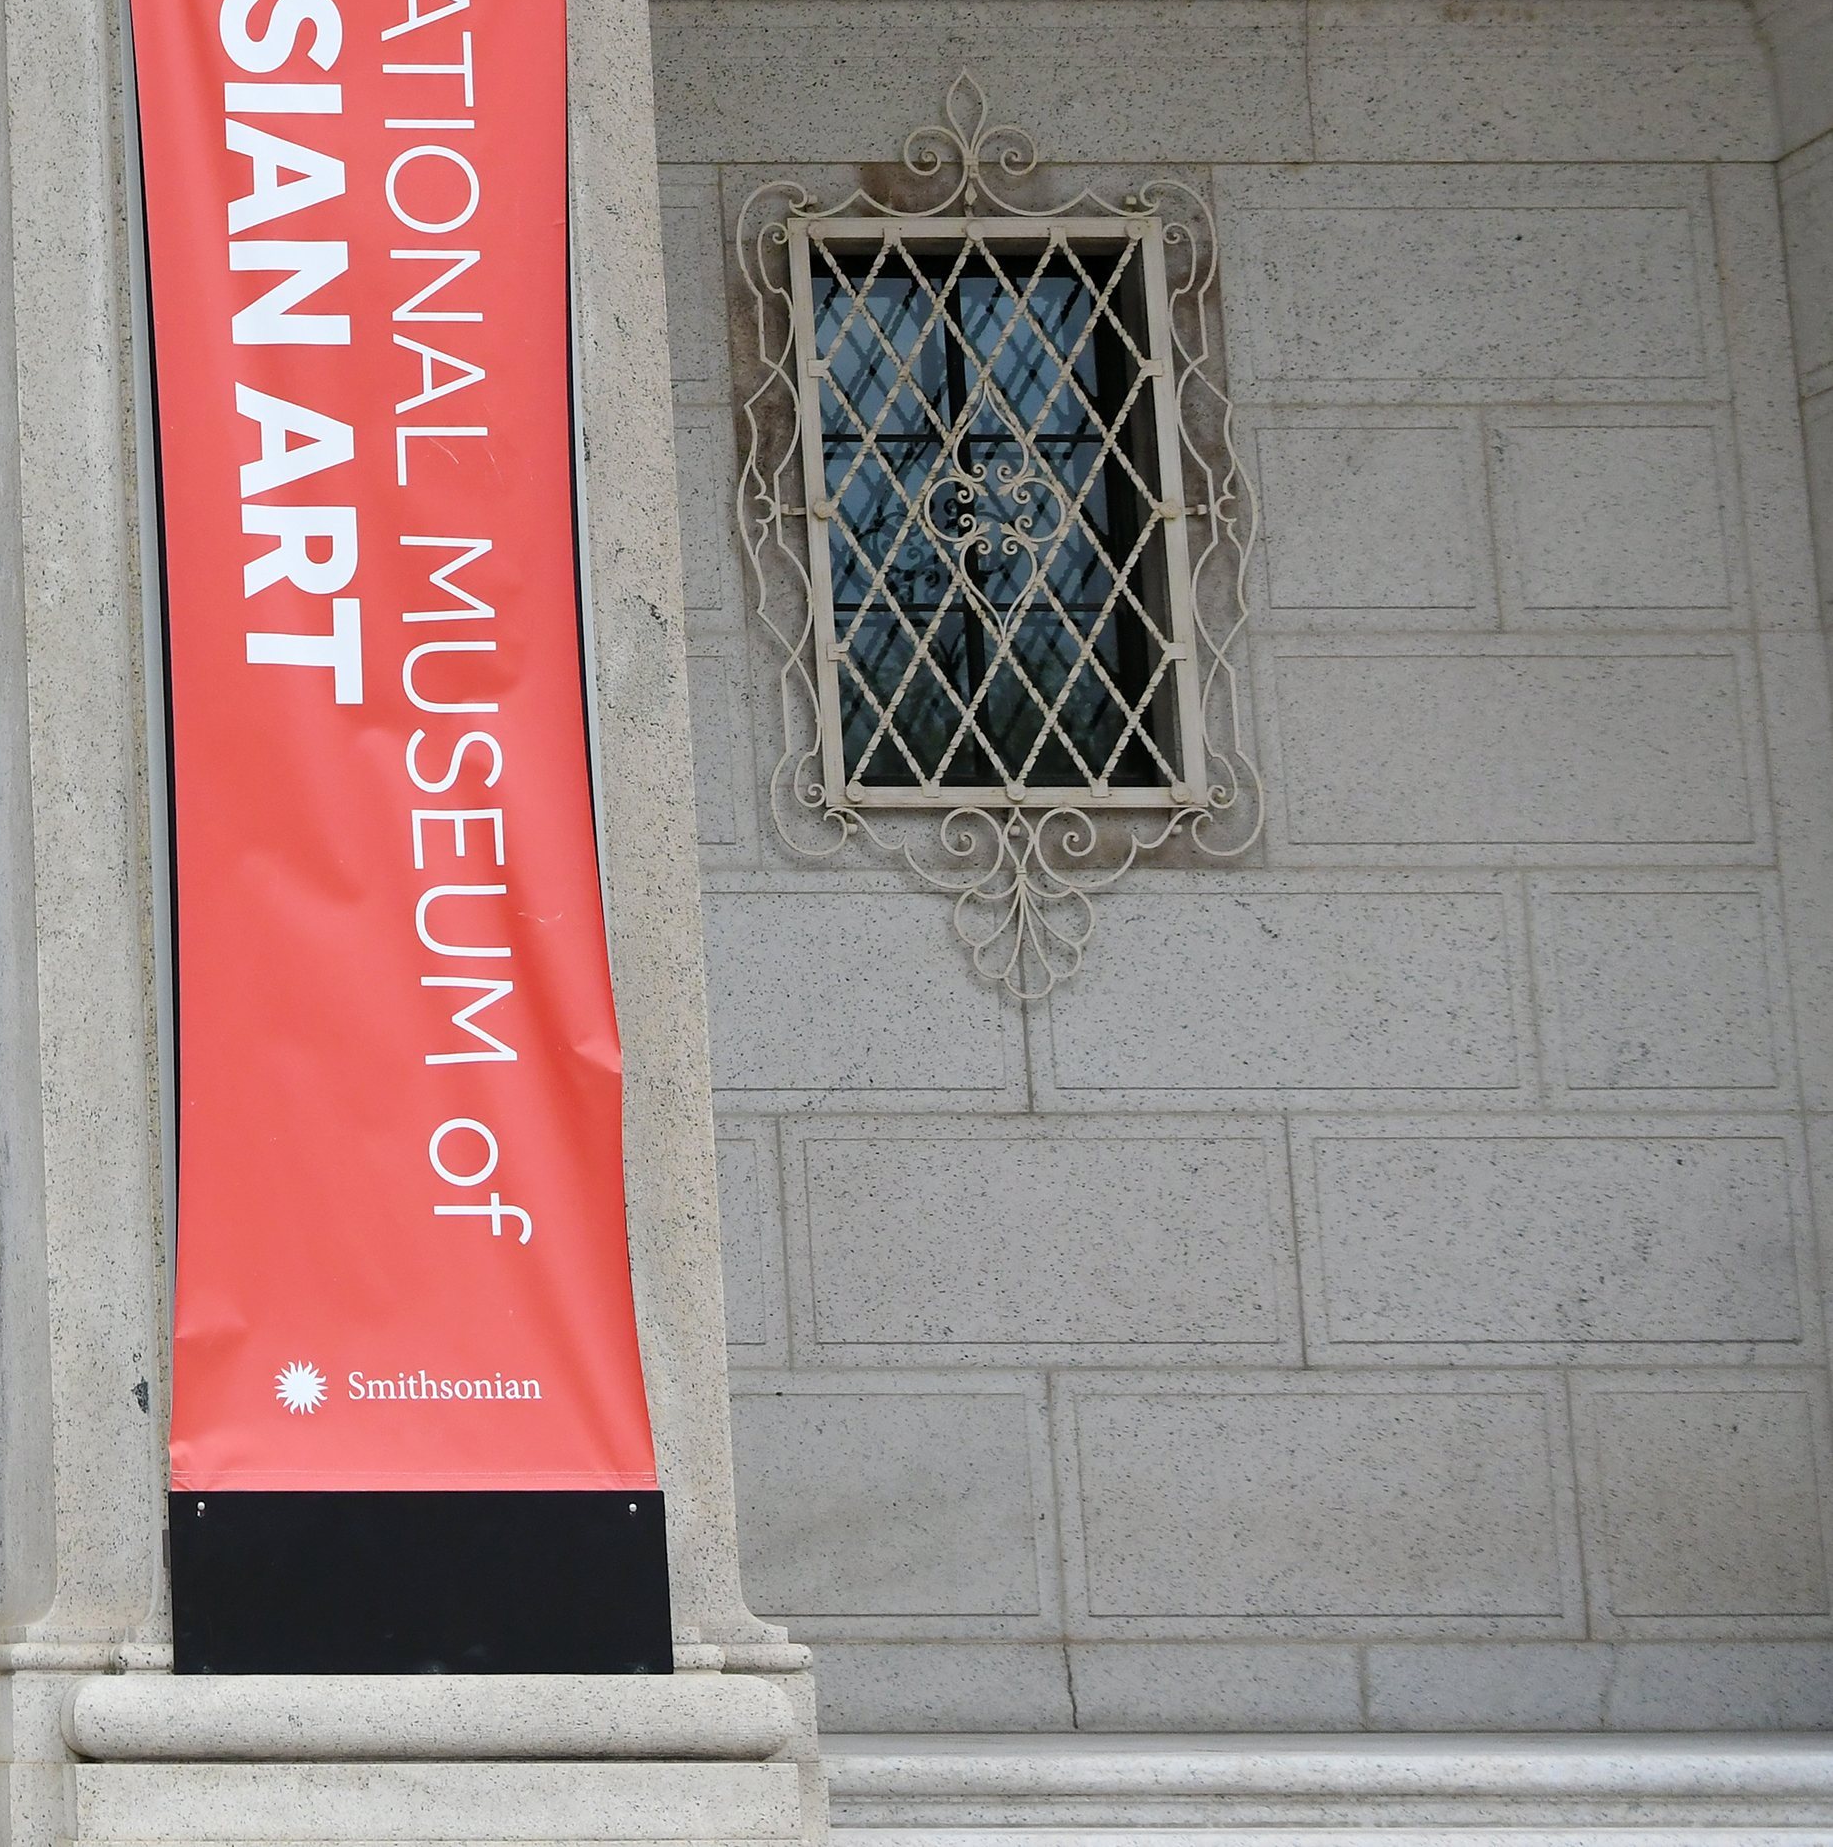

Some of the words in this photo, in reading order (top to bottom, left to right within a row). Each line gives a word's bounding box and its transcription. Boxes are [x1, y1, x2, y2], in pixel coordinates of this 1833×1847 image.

[234, 381, 364, 705] ART
[399, 535, 518, 1065] MUSEUM
[428, 1117, 533, 1245] of
[347, 1370, 543, 1400] Smithsonian
